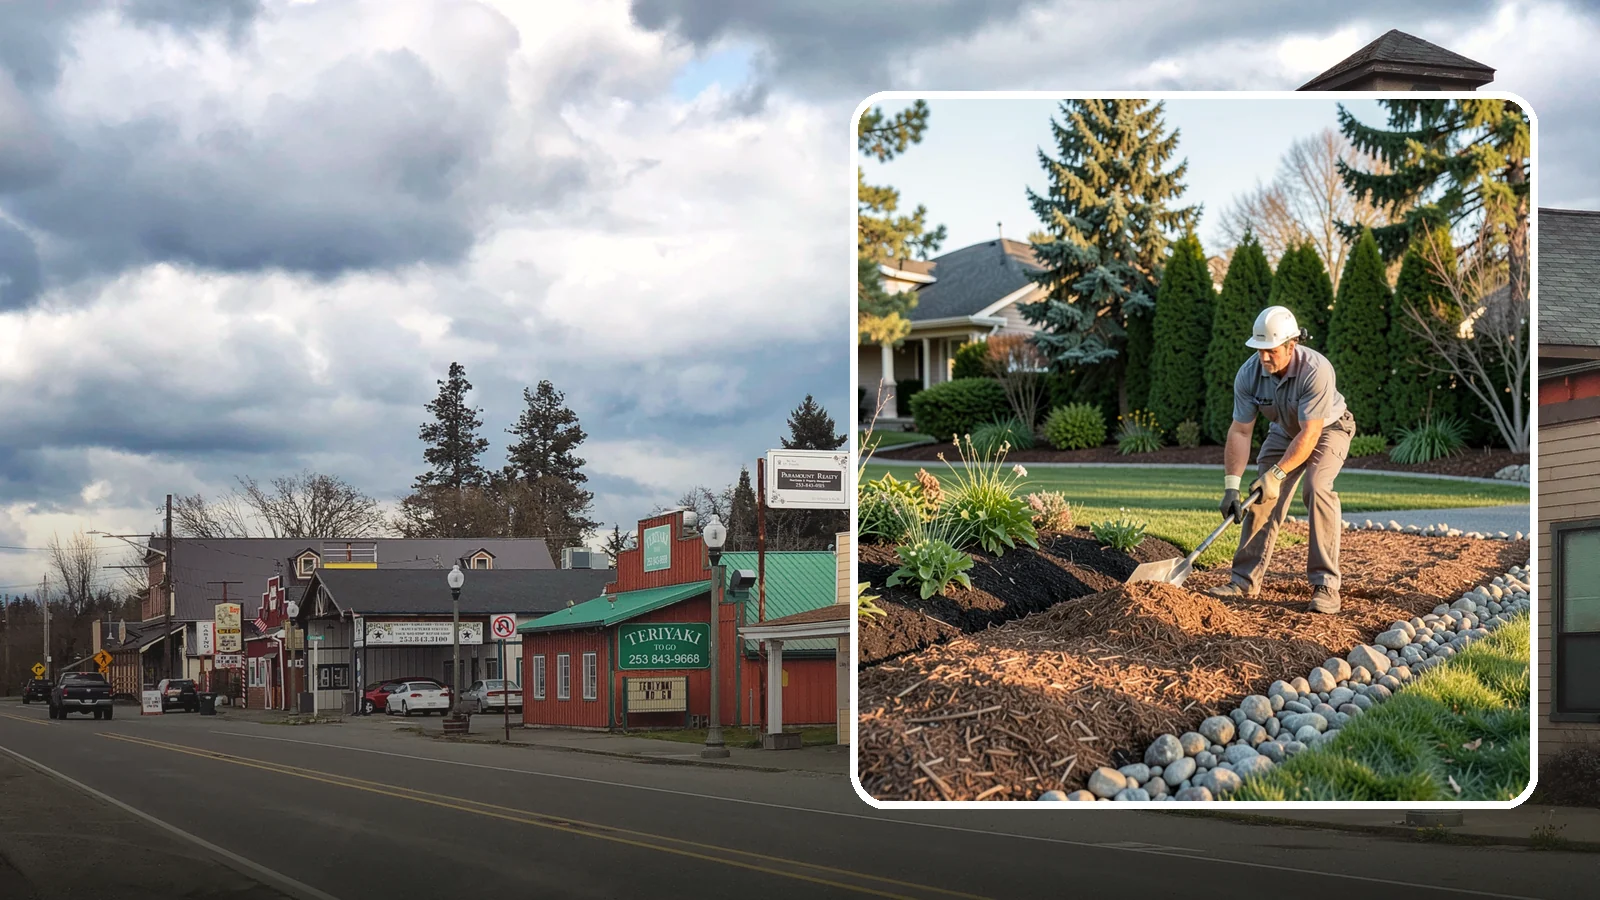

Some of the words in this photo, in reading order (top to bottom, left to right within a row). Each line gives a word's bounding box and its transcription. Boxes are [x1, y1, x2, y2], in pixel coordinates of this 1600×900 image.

[625, 628, 702, 646] TERIYAKI
[628, 654, 648, 664] 253
[651, 653, 700, 664] 843-9668
